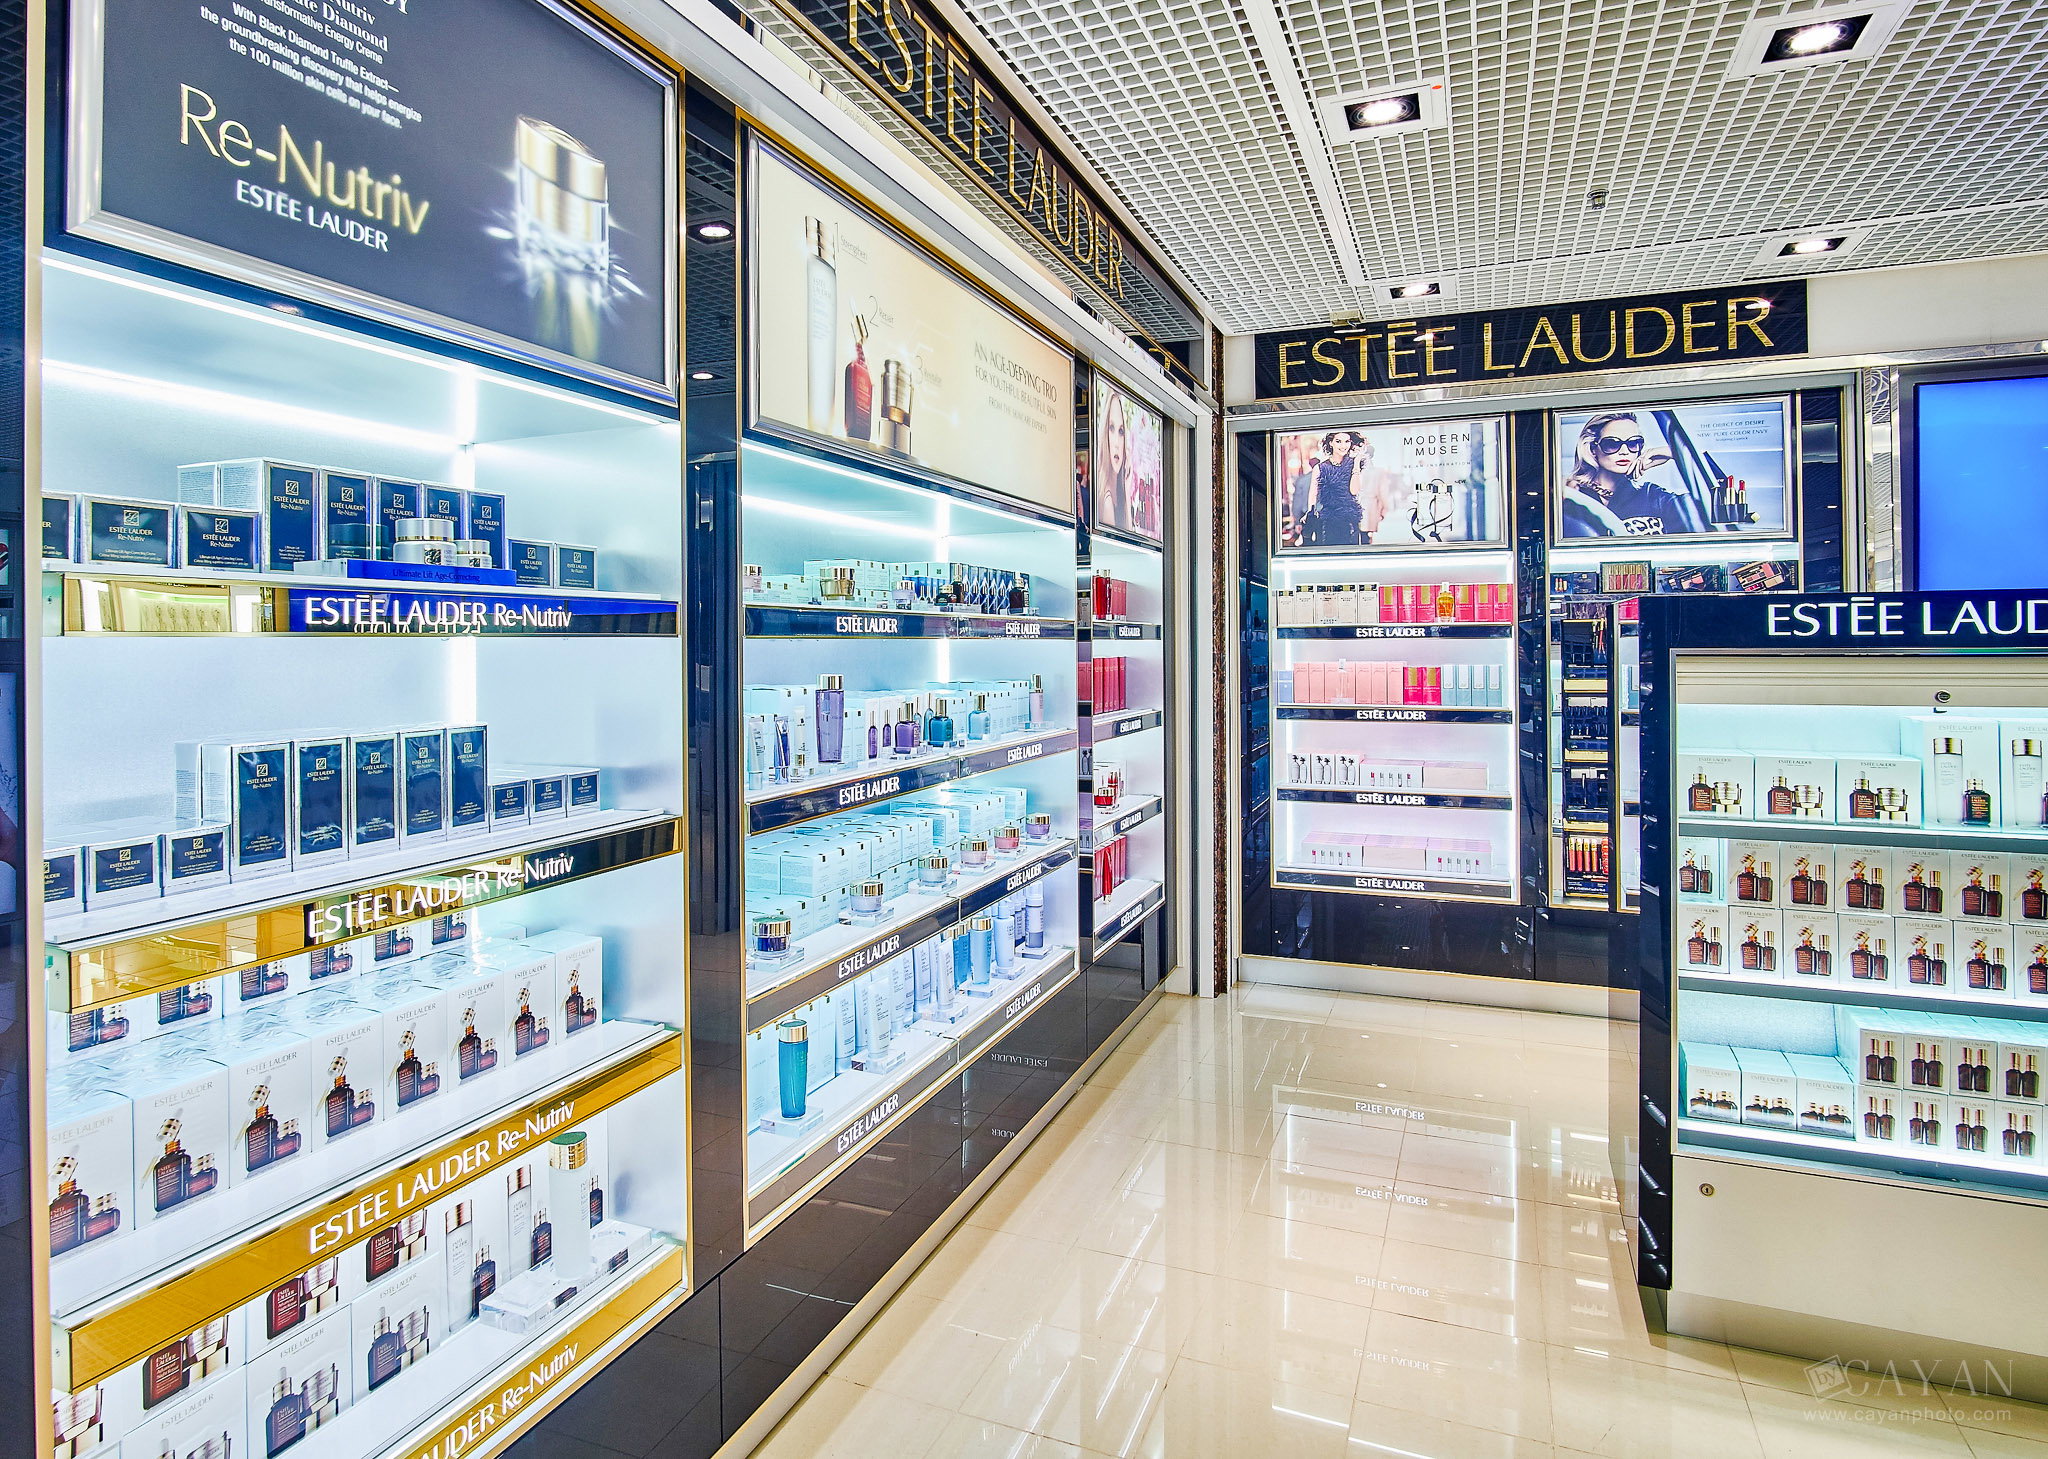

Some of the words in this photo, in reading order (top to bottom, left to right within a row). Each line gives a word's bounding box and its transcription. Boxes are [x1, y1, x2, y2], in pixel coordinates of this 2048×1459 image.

[232, 2, 257, 25] With
[258, 15, 287, 39] Black
[288, 29, 330, 60] Diamond
[330, 50, 359, 75] Truffle
[322, 2, 389, 52] Diamond
[324, 23, 355, 51] Energy
[355, 41, 383, 64] Creme
[200, 5, 219, 24] the
[221, 16, 300, 65] groundbreaking
[301, 53, 345, 86] discovery
[345, 75, 363, 94] that
[363, 83, 388, 106] helps
[388, 96, 423, 123] energize
[229, 37, 247, 56] the
[249, 47, 271, 66] 100
[272, 58, 305, 83] million
[305, 74, 326, 93] skin
[348, 94, 361, 110] on
[361, 100, 381, 120] your
[180, 82, 430, 234] Re-Nutriv
[1007, 115, 1125, 299] LAUDER
[307, 205, 389, 252] LAUDER
[869, 295, 879, 327] 2
[1482, 296, 1776, 373] LAUDER
[974, 341, 988, 363] AN
[990, 351, 1042, 395] AGE-DEFYING
[1042, 378, 1058, 403] TRIO
[975, 365, 989, 384] FOR
[989, 373, 1020, 401] YOUTHFUL
[1020, 391, 1046, 416] BEAUTIFUL
[1403, 433, 1470, 446] MODERN
[1415, 445, 1458, 456] MUSE
[219, 535, 241, 543] LAUDER
[392, 569, 422, 578] Ultimate
[422, 570, 433, 579] Lift
[434, 571, 480, 583] Age-Correcting
[393, 600, 488, 626] LAUDER
[493, 603, 573, 628] Re-Nutriv
[864, 617, 898, 634] LAUDER
[1386, 627, 1426, 638] LAUDER
[1387, 710, 1427, 722] LAUDER
[1023, 742, 1043, 759] LAUDER
[866, 776, 900, 800] LAUDER
[1386, 794, 1426, 806] LAUDER
[396, 871, 490, 915] LAUDER
[496, 852, 574, 889] Re-Nutriv
[1023, 862, 1042, 884] LAUDER
[1385, 879, 1425, 891] LAUDER
[866, 935, 900, 966] LAUDER
[529, 963, 547, 976] LAUDER
[473, 981, 495, 995] LAUDER
[1023, 982, 1042, 1007] LAUDER
[414, 1002, 437, 1016] LAUDER
[346, 1025, 371, 1041] LAUDER
[269, 1051, 297, 1068] LAUDER
[180, 1081, 213, 1098] LAUDER
[865, 1093, 899, 1136] LAUDER
[396, 1139, 490, 1208] LAUDER
[496, 1099, 576, 1158] Re-Nutriv
[501, 1341, 580, 1415] Re-Nutriv
